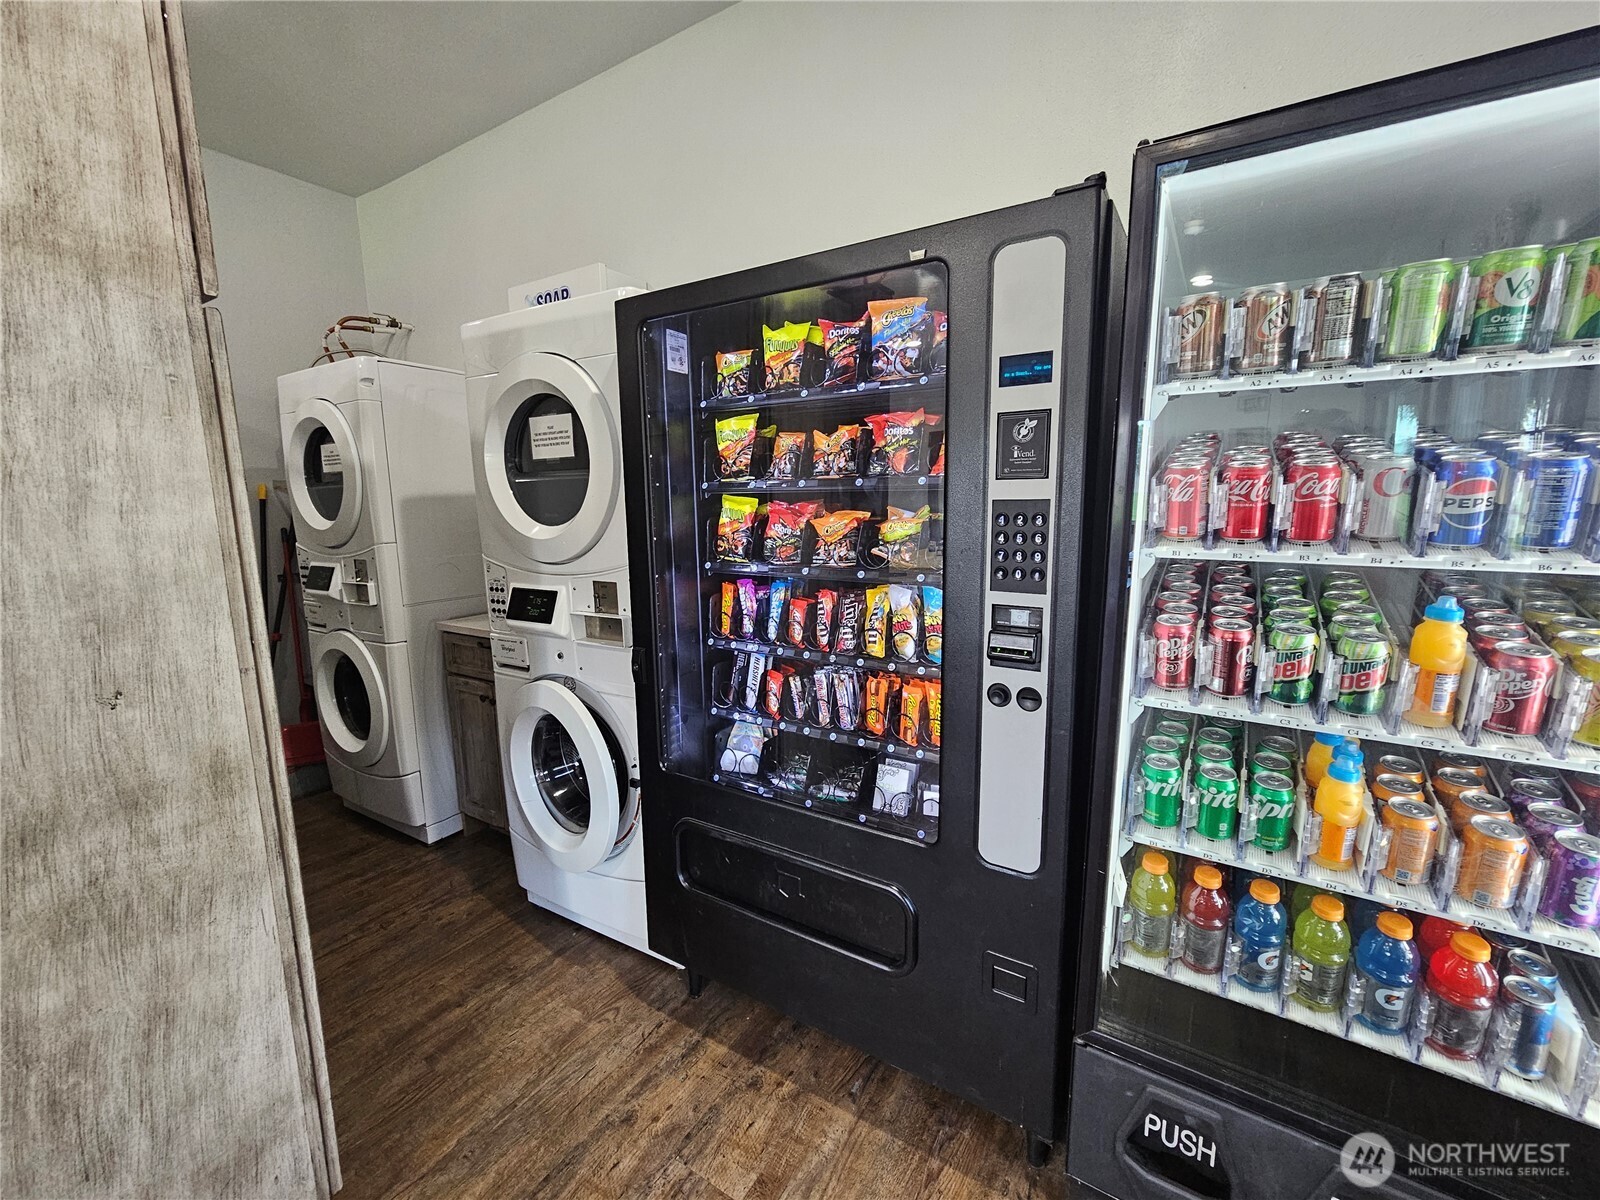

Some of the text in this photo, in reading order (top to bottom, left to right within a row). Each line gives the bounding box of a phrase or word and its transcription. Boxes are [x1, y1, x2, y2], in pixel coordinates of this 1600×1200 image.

[1505, 271, 1535, 300] V8
[828, 326, 860, 339] Doritos
[1577, 353, 1595, 362] A6
[1484, 361, 1500, 370] A5
[1399, 368, 1413, 376] A4
[1319, 374, 1333, 382] A3
[1250, 379, 1262, 387] A2
[1017, 515, 1023, 525] 2
[1036, 515, 1042, 525] 3
[998, 533, 1042, 543] 4 5 6
[998, 551, 1041, 562] 7 8 9
[1451, 560, 1464, 568] B5
[1538, 564, 1553, 572] B6
[1015, 569, 1022, 579] 0
[1170, 637, 1186, 650] Dr
[1156, 639, 1195, 660] Pepper
[1499, 668, 1528, 683] Dr
[1496, 678, 1543, 695] pper
[1347, 728, 1359, 736] C4
[1420, 739, 1434, 748] C5
[1502, 752, 1517, 760] C6
[1198, 786, 1238, 809] rite
[1262, 867, 1272, 875] D3
[1569, 876, 1599, 916] Crush
[1395, 900, 1408, 908] D5
[1472, 919, 1486, 928] D6
[1557, 940, 1572, 948] D7
[1144, 1113, 1217, 1168] PUSH
